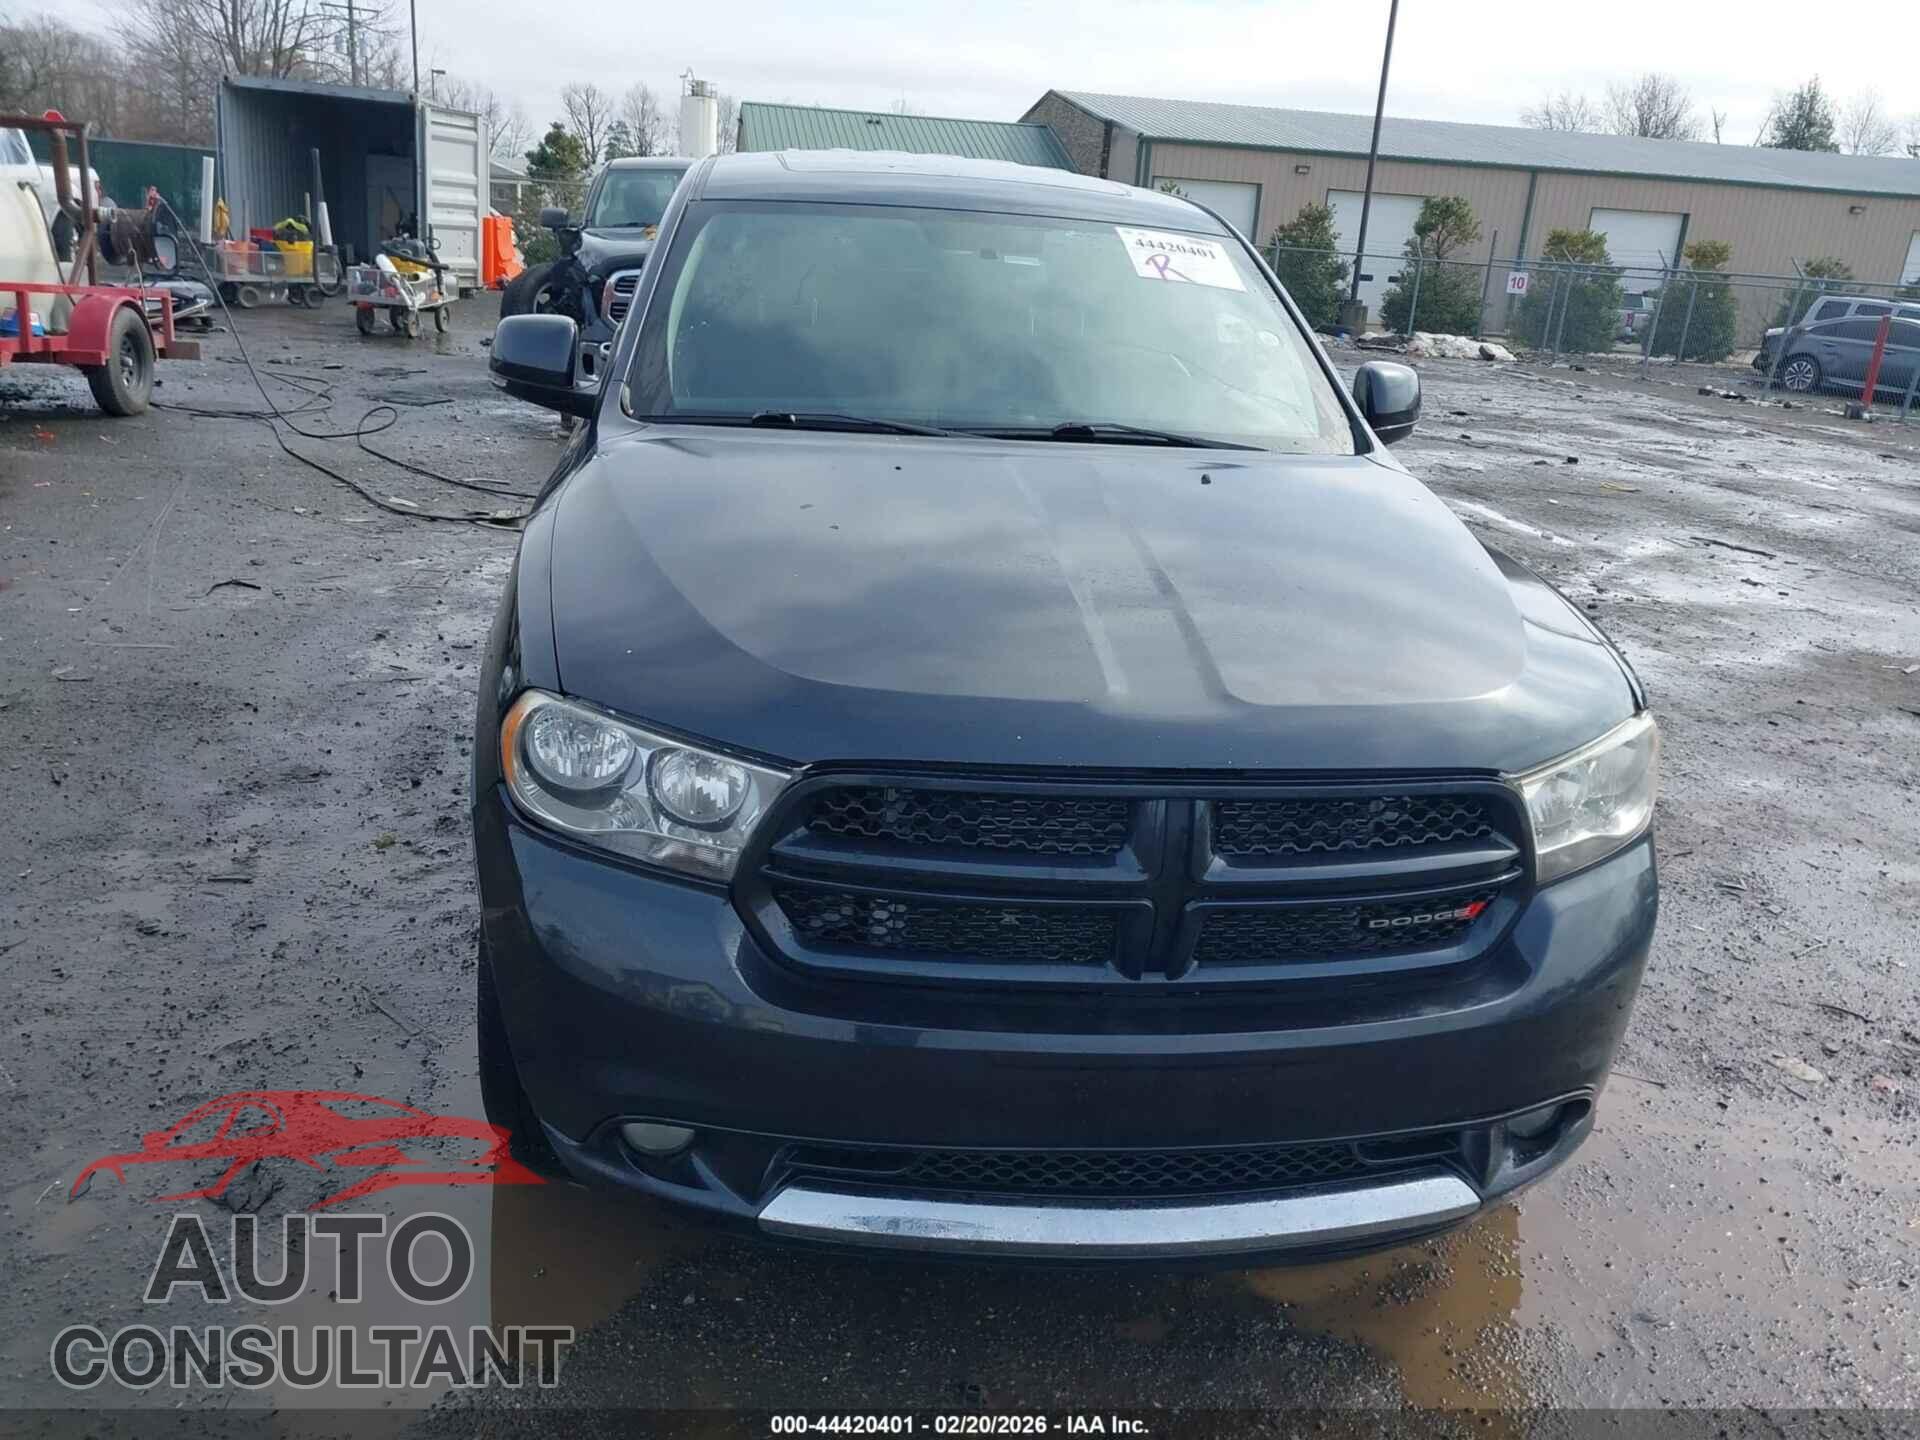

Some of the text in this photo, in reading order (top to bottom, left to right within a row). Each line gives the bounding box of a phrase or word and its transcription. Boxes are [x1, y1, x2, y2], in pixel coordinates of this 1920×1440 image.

[1136, 238, 1216, 260] 44420401
[1144, 253, 1193, 281] R
[1511, 276, 1525, 289] 10
[1368, 908, 1471, 928] DODGE
